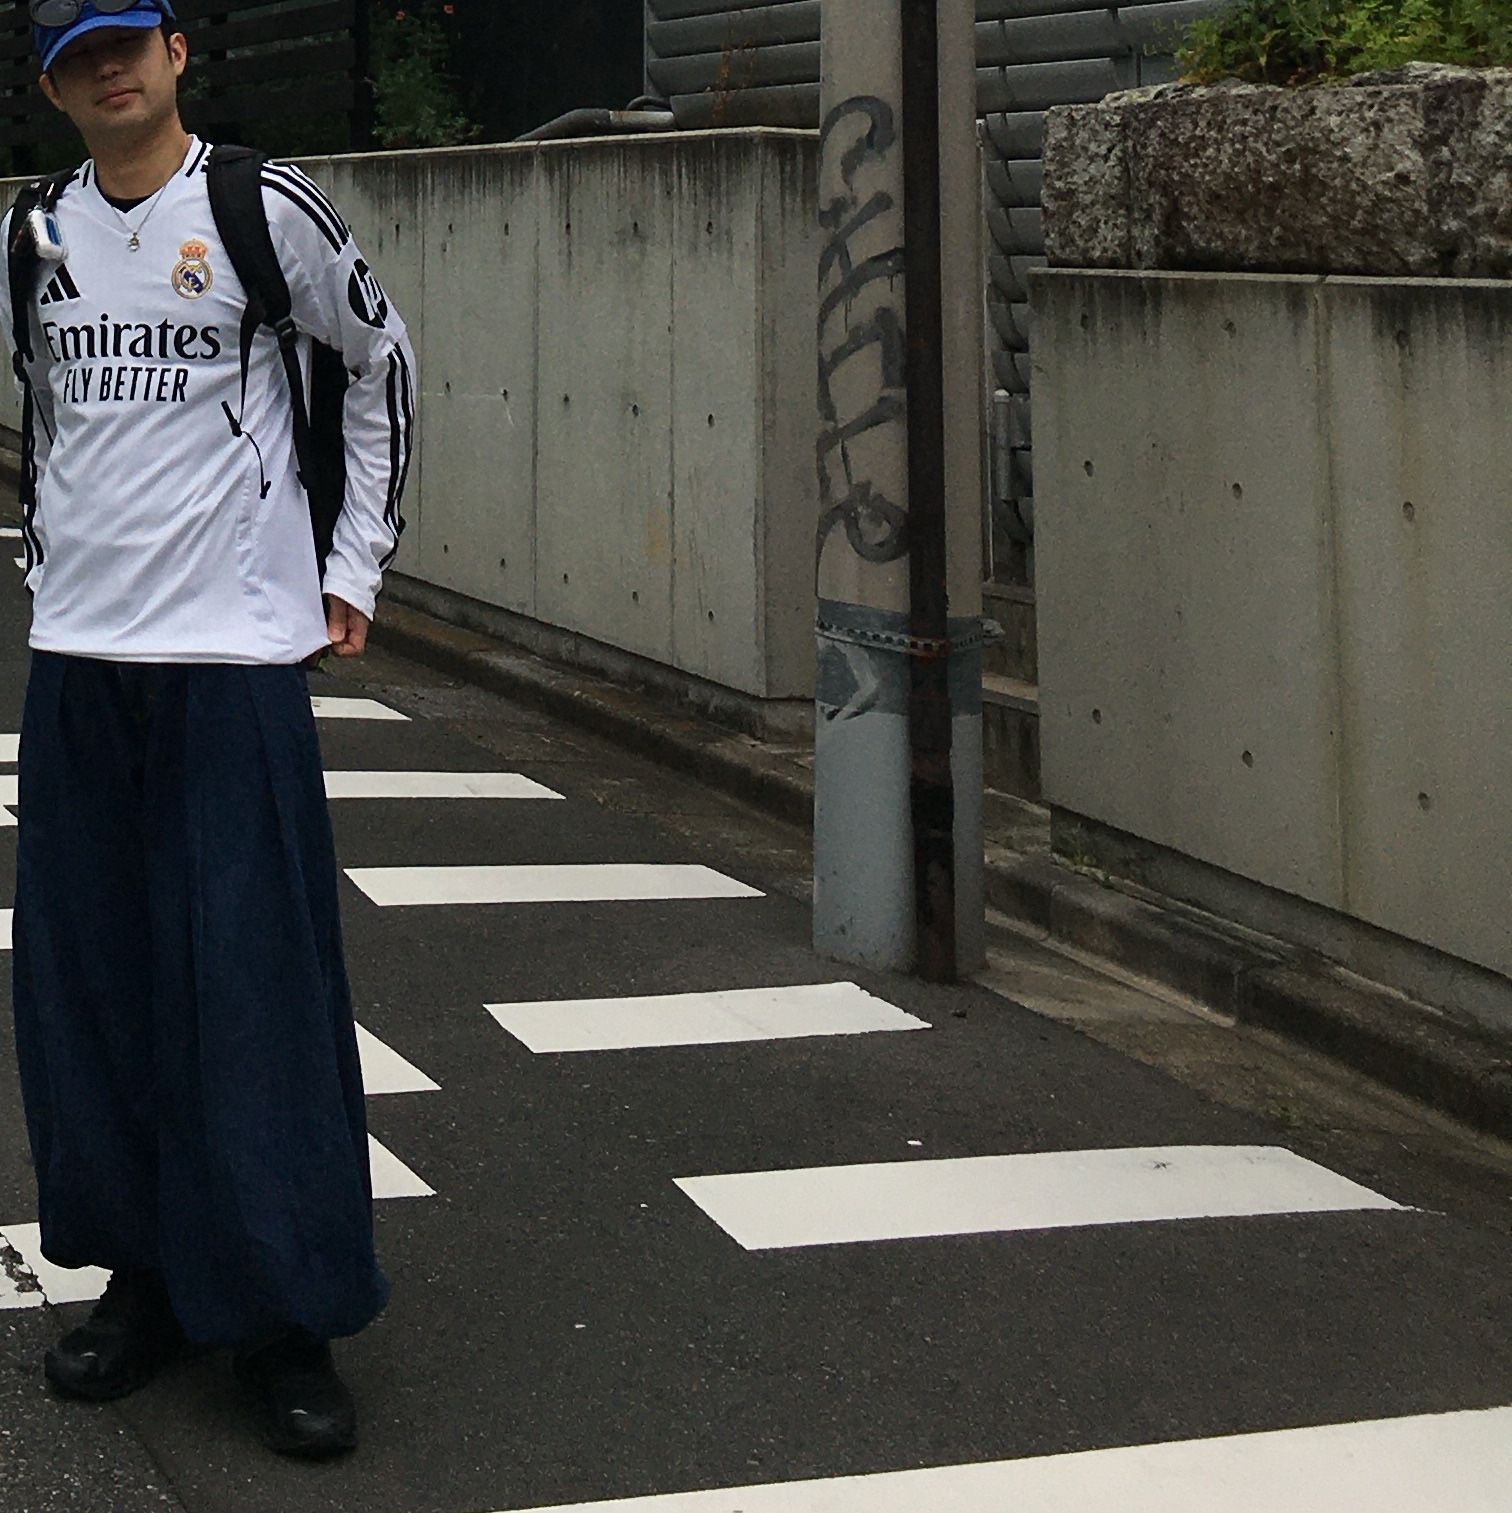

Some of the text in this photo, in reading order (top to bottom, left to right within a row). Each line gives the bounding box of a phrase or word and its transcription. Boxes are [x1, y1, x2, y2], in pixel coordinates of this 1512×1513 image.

[42, 313, 221, 363] Emirates
[63, 366, 189, 404] FLY BETTER
